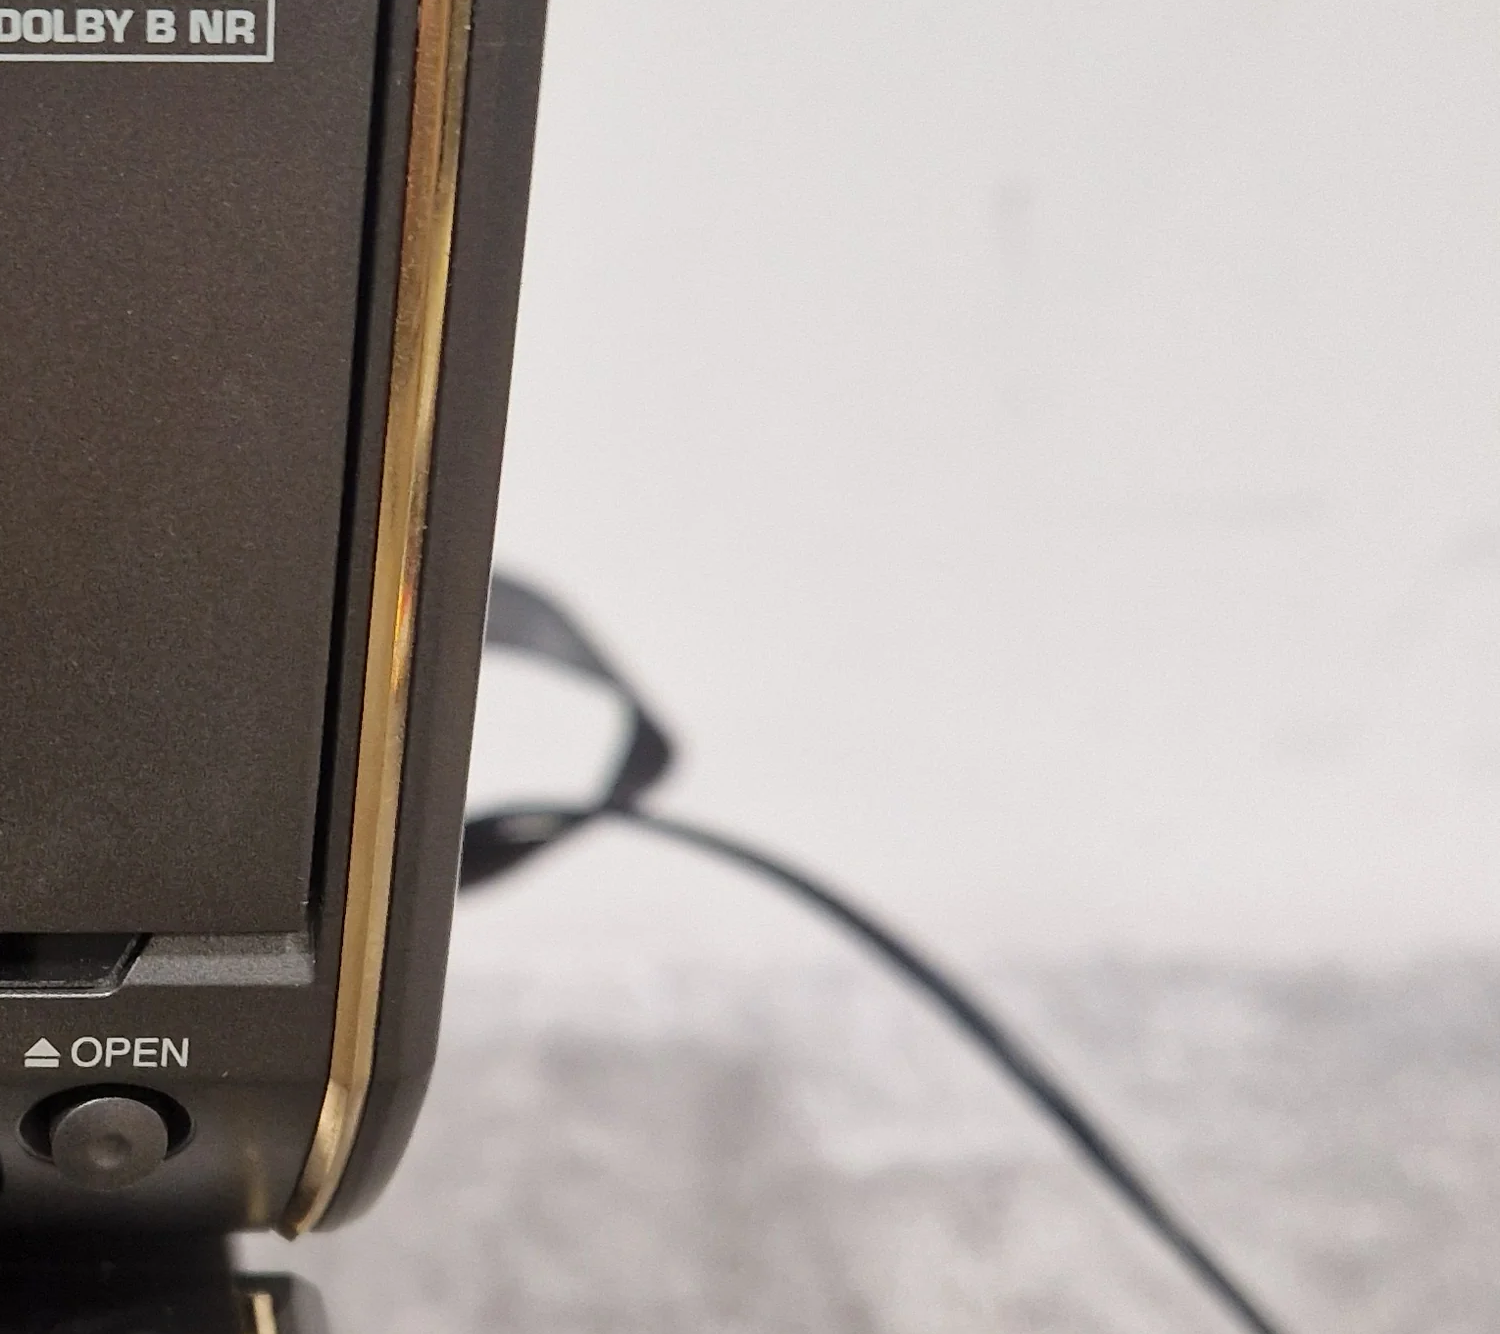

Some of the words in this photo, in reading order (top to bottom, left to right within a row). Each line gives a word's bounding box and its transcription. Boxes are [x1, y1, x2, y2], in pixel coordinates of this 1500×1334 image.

[145, 10, 176, 43] B
[189, 10, 256, 45] NR
[71, 1036, 191, 1069] OPEN
